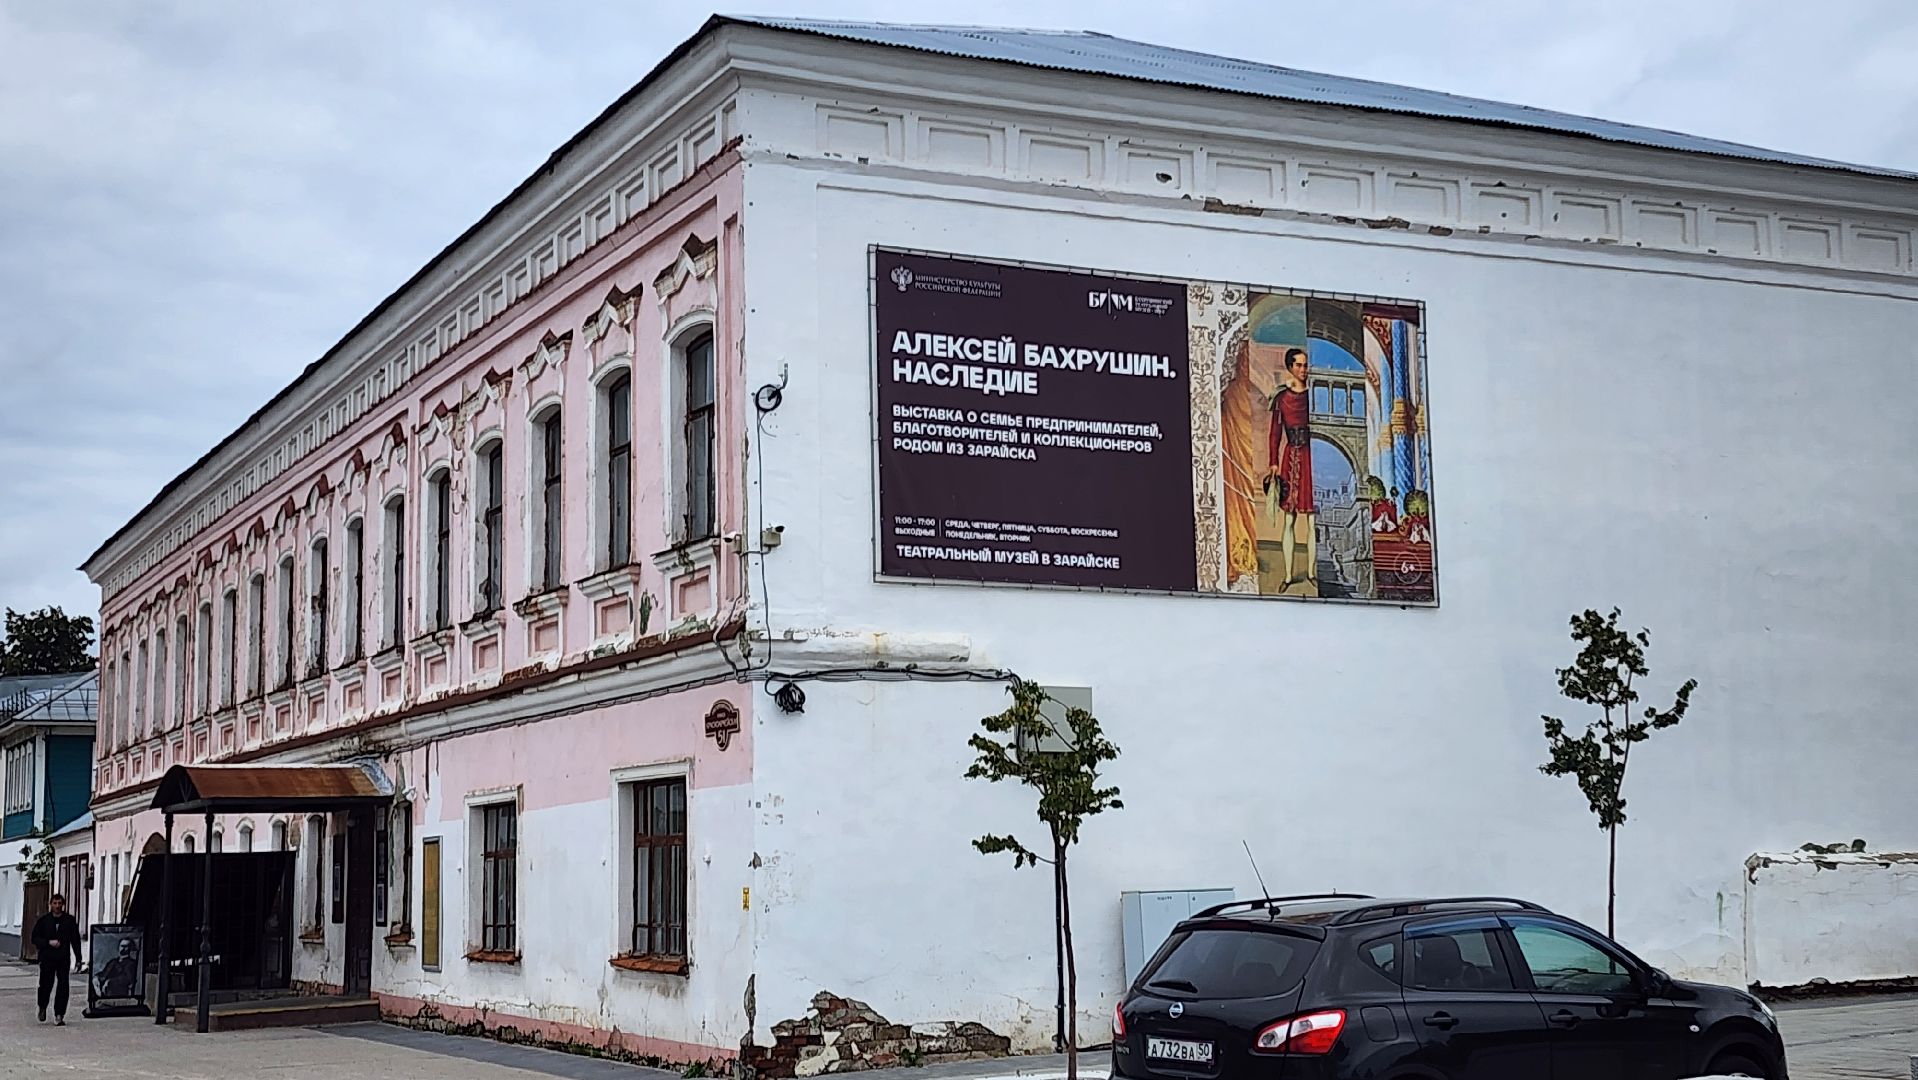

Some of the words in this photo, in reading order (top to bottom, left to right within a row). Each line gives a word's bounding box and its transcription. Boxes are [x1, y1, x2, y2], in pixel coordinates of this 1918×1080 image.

[892, 330, 1016, 364] АЛЕКСЕЙ
[1024, 344, 1176, 378] БАХРУШИН.
[893, 359, 1037, 396] НАСЛЕДИЕ
[893, 405, 964, 422] ВЫСТАВКА
[967, 411, 977, 423] О
[980, 412, 1022, 427] СЕМЬЕ
[1026, 416, 1163, 440] ПРЕДПРИНИМАТЕЛЕЙ,
[893, 421, 1018, 443] БЛАГОТВОРИТЕЛЕЙ
[1021, 432, 1030, 444] И
[1034, 433, 1152, 453] КОЛЛЕКЦИОНЕРОВ
[893, 437, 943, 453] РОДОМ
[946, 442, 964, 455] ИЗ
[967, 444, 1036, 460] ЗАРАЙСКА
[895, 516, 912, 525] 11:00
[917, 518, 935, 526] 17:00
[945, 520, 971, 529] СРЕДА,
[971, 521, 1001, 531] ЧЕТВЕРГ,
[1002, 523, 1036, 533] ПЯТНИЦА,
[1037, 526, 1070, 535] СУББОТА,
[1070, 527, 1119, 538] ВОСКРЕСЕНЬЕ
[895, 527, 935, 537] ВЫХОДНЫЕ
[945, 530, 998, 541] ПОНЕДЕЛЬНИК,
[999, 533, 1031, 542] ВТОРНИК
[896, 544, 992, 562] ТЕАТРАЛЬНЫЙ
[994, 550, 1039, 564] МУЗЕЙ
[1041, 553, 1050, 565] В
[1053, 553, 1120, 569] ЗАРАЙСКЕ
[1401, 562, 1415, 573] 6+
[1197, 1043, 1209, 1056] 50
